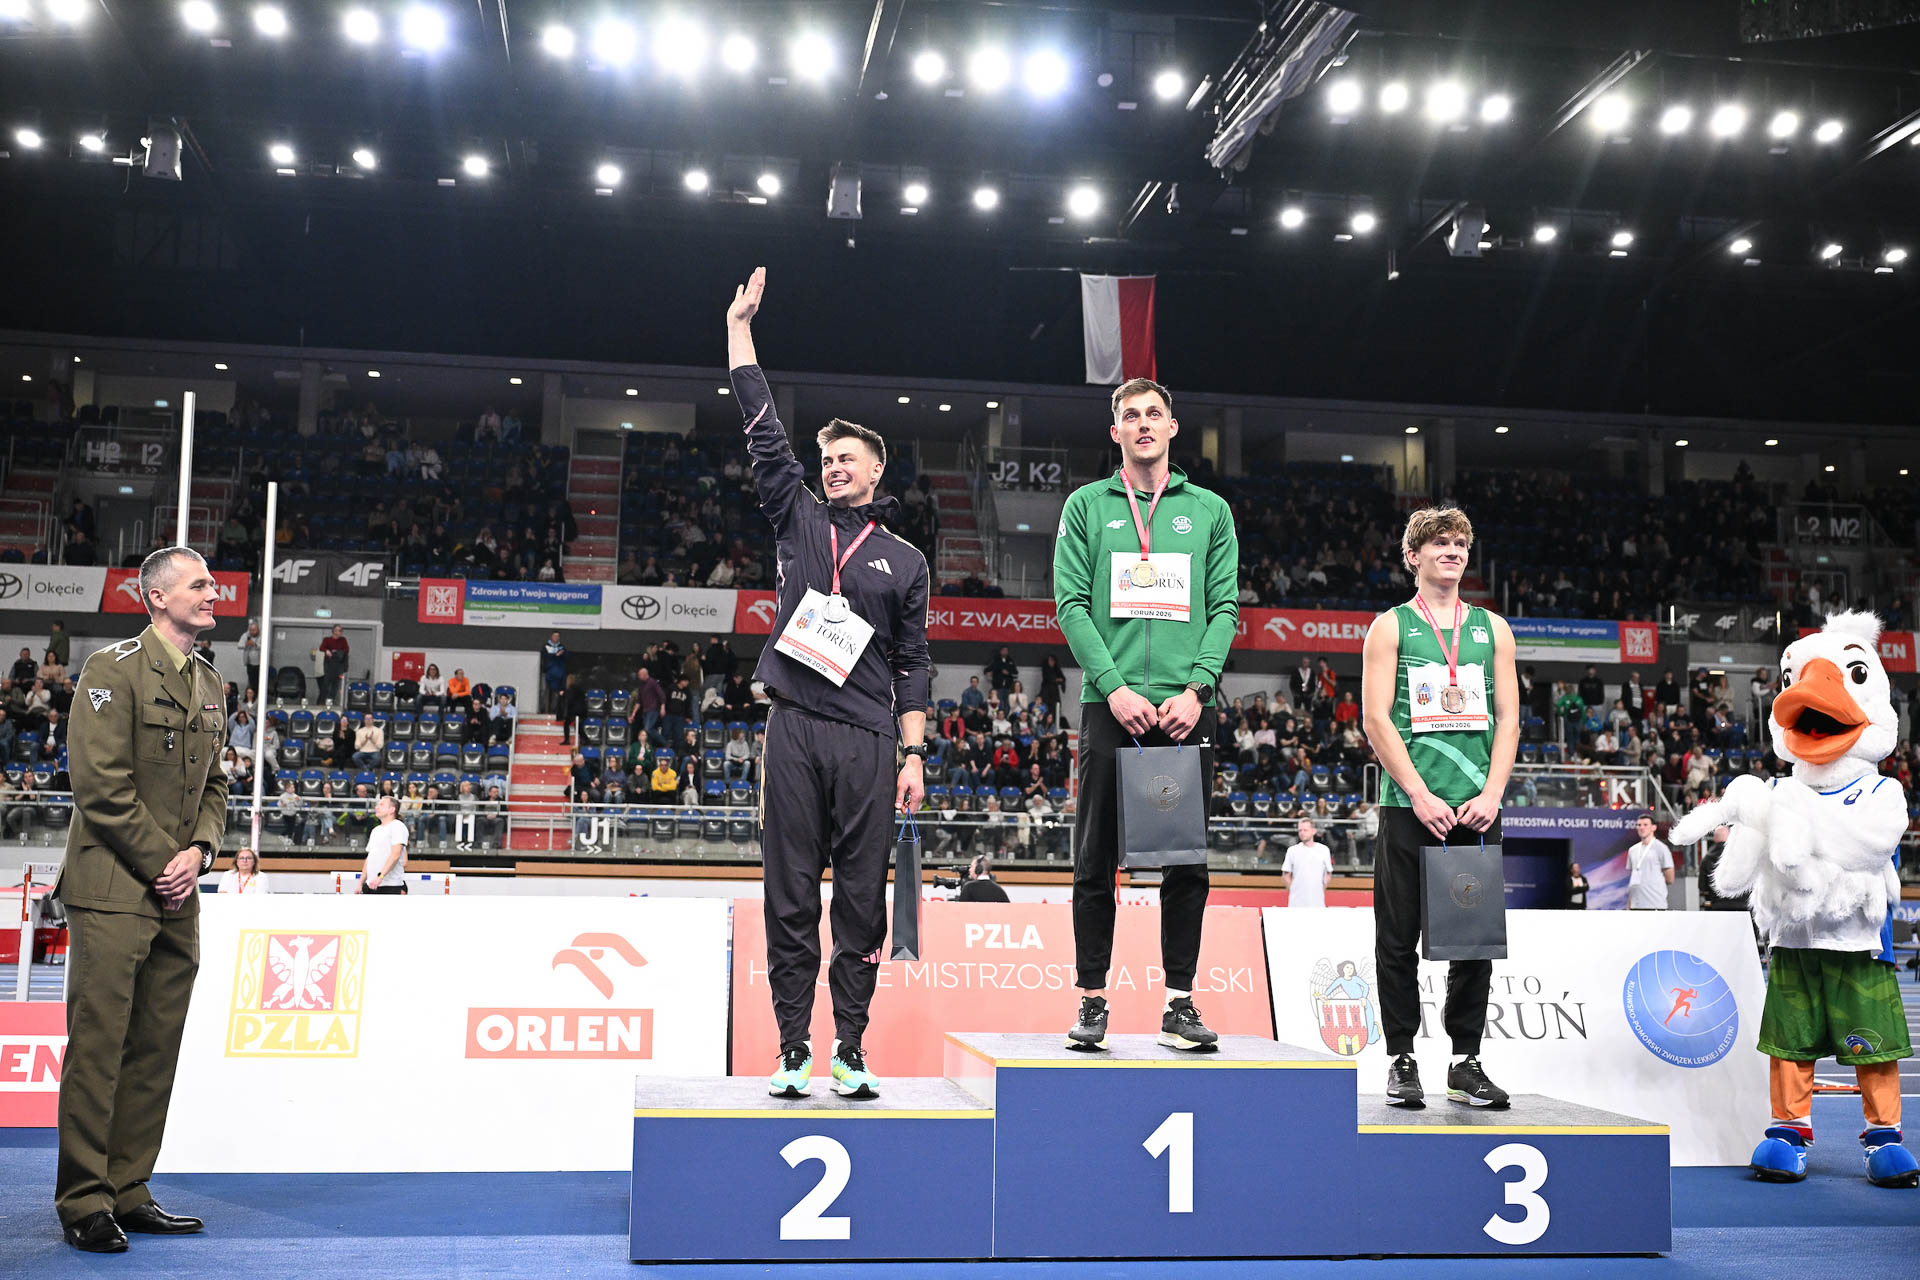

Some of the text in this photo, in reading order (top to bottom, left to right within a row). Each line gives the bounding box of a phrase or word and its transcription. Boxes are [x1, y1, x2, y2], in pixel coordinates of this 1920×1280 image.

[991, 461, 1061, 483] J2 K2
[1106, 520, 1127, 529] 4F
[1830, 517, 1861, 538] M2
[272, 559, 316, 583] 4F
[338, 562, 384, 586] 4F
[34, 581, 84, 597] Okęcie
[471, 586, 589, 601] Zdrowie to Twoja wygrana
[428, 606, 454, 615] PZLA
[671, 603, 718, 619] Okęcie
[960, 612, 1059, 631] ZWIĄZEK
[1715, 615, 1738, 629] 4F
[1302, 621, 1369, 640] ORLEN
[1752, 617, 1776, 630] 4F
[816, 623, 857, 655] TORUŃ
[812, 660, 828, 673] 2026
[1611, 778, 1642, 804] K1
[579, 817, 610, 845] J1
[1501, 817, 1556, 828] ISTRZOSTWA
[1558, 817, 1589, 828] POLSKI
[1592, 816, 1622, 829] TORUŃ
[965, 923, 1044, 950] PZLA
[905, 962, 1136, 991] MISTRZOSTA
[1146, 965, 1255, 992] PLSKI
[1418, 975, 1542, 996] MITO
[1419, 991, 1588, 1040] TRUŃ
[1626, 980, 1735, 1066] KUJAWSKO-POMORSKI ZWIĄZEK LEKKIEJ ATLETYKI
[232, 1015, 350, 1051] PZLA
[476, 1014, 642, 1053] ORLEN
[1142, 1112, 1194, 1212] 1
[779, 1135, 851, 1240] 2
[1482, 1143, 1550, 1245] 3
